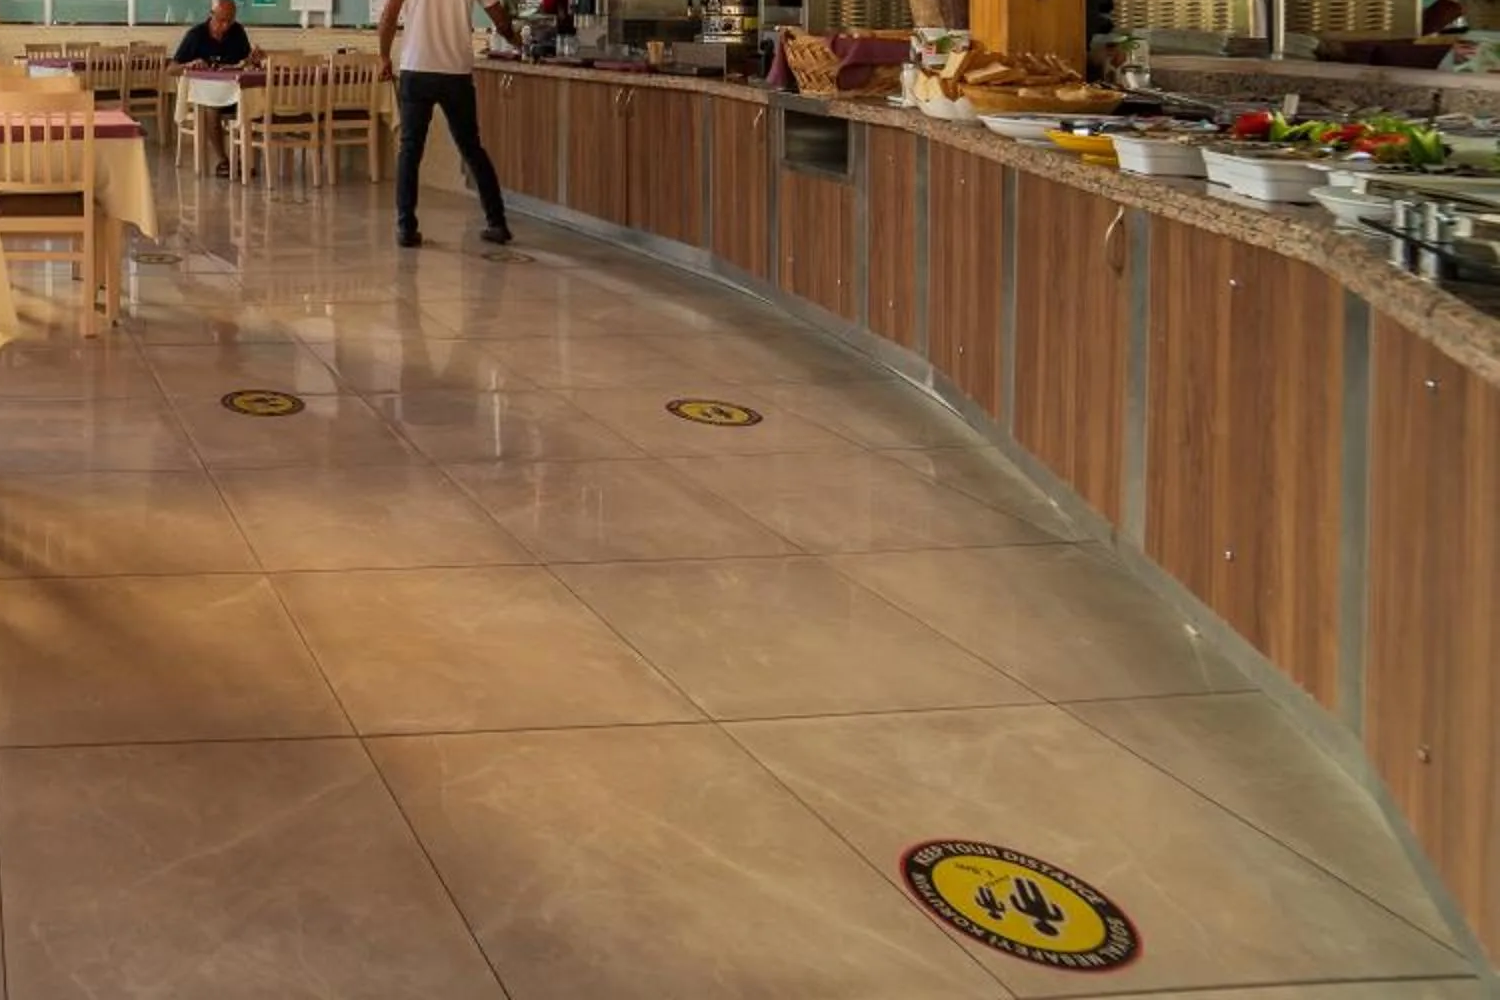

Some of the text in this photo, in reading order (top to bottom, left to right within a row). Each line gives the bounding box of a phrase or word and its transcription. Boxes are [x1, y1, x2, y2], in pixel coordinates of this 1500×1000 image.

[914, 846, 943, 866] KEEP
[943, 843, 999, 857] YOUR
[1003, 850, 1104, 905] DISTANCE
